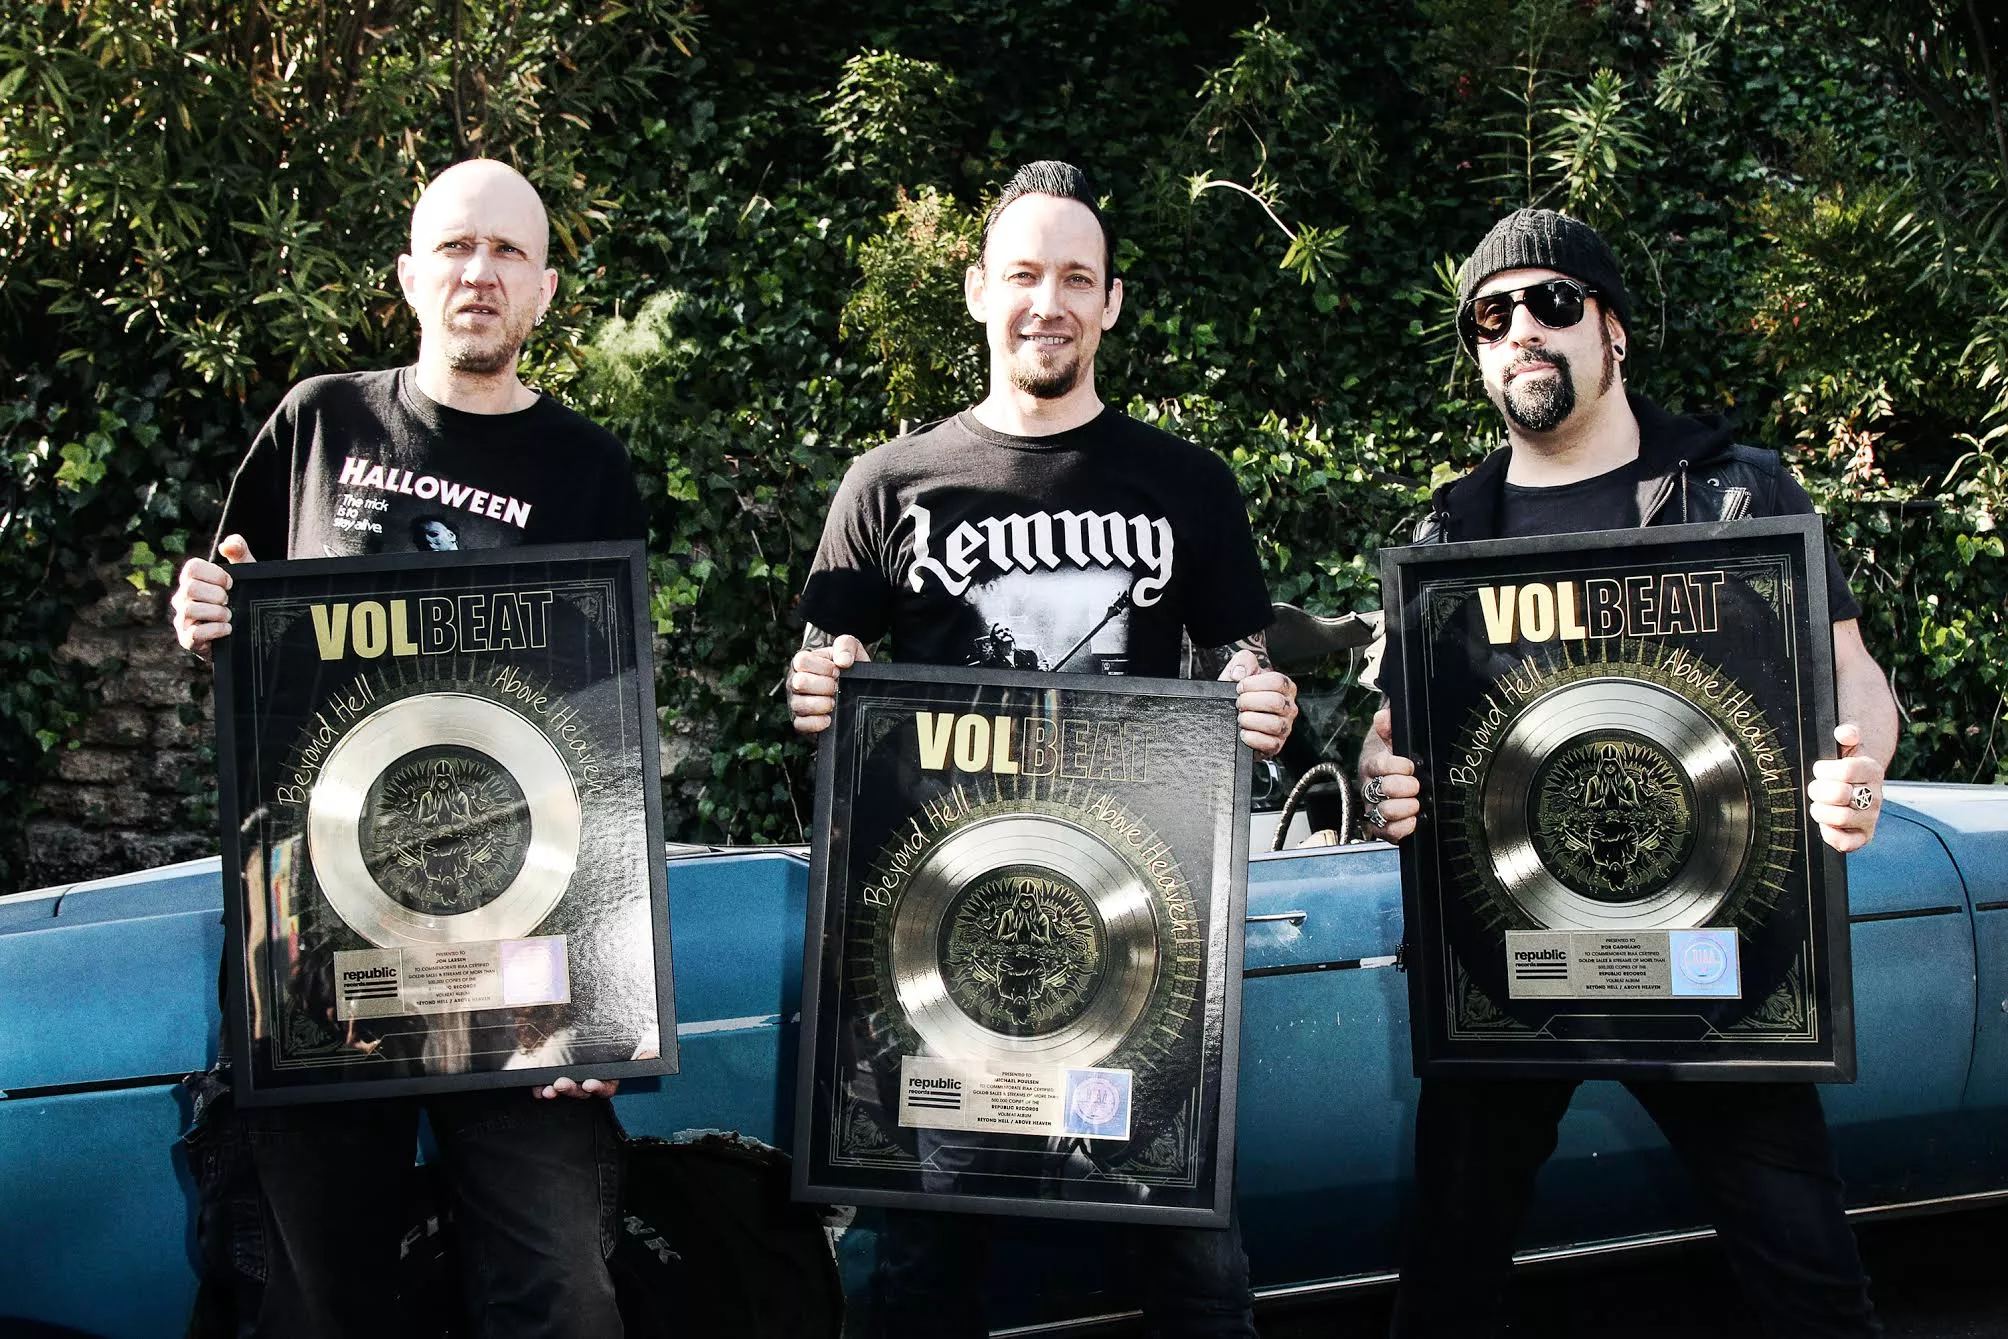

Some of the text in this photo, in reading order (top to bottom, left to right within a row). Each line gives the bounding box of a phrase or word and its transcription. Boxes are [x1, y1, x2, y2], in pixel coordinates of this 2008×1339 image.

[333, 517, 354, 532] stay
[337, 456, 533, 529] HALLOWEEN
[342, 494, 389, 512] The trick
[901, 503, 1174, 608] Lemmy
[310, 590, 553, 661] VOLBEAT
[1477, 570, 1725, 645] VOLBEAT
[277, 672, 376, 806] Beyond Hell
[492, 665, 604, 796] Above Heaven
[915, 711, 1159, 782] VOLBEAT
[1449, 653, 1544, 787] Beyond Hell
[1663, 648, 1780, 785] Above Heaven
[863, 783, 972, 907] Beyond Hell
[1087, 792, 1188, 934] Above Heaven
[343, 967, 397, 981] republic
[1515, 949, 1567, 962] republic
[909, 1078, 962, 1089] republic
